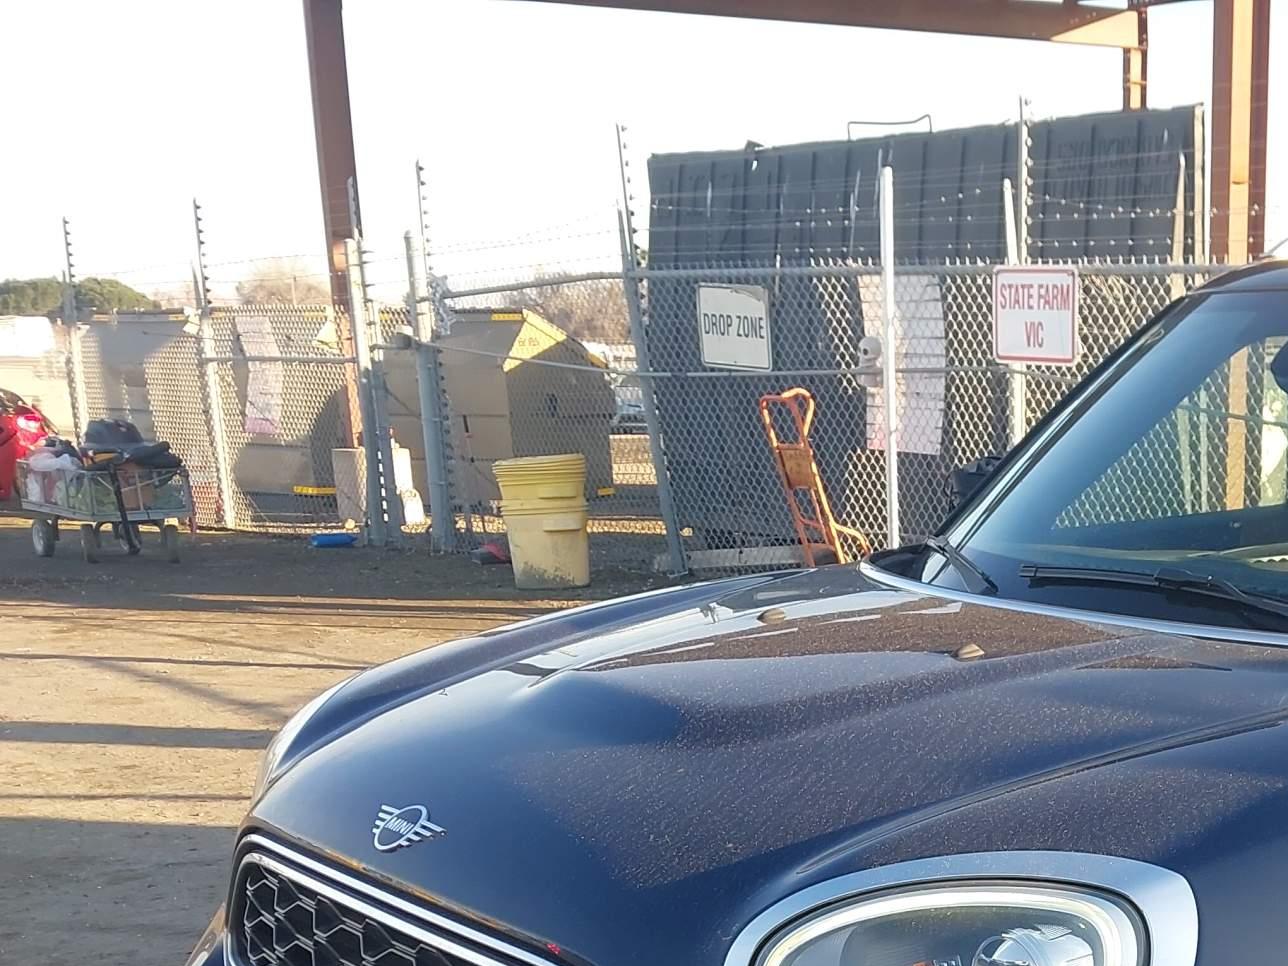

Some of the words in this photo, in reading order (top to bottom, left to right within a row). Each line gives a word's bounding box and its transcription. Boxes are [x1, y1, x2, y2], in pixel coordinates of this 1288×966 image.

[1000, 283, 1034, 310] STATE
[1037, 283, 1070, 311] FARM
[703, 312, 733, 337] DROP
[736, 314, 765, 340] ZONE
[1024, 321, 1044, 348] VIC
